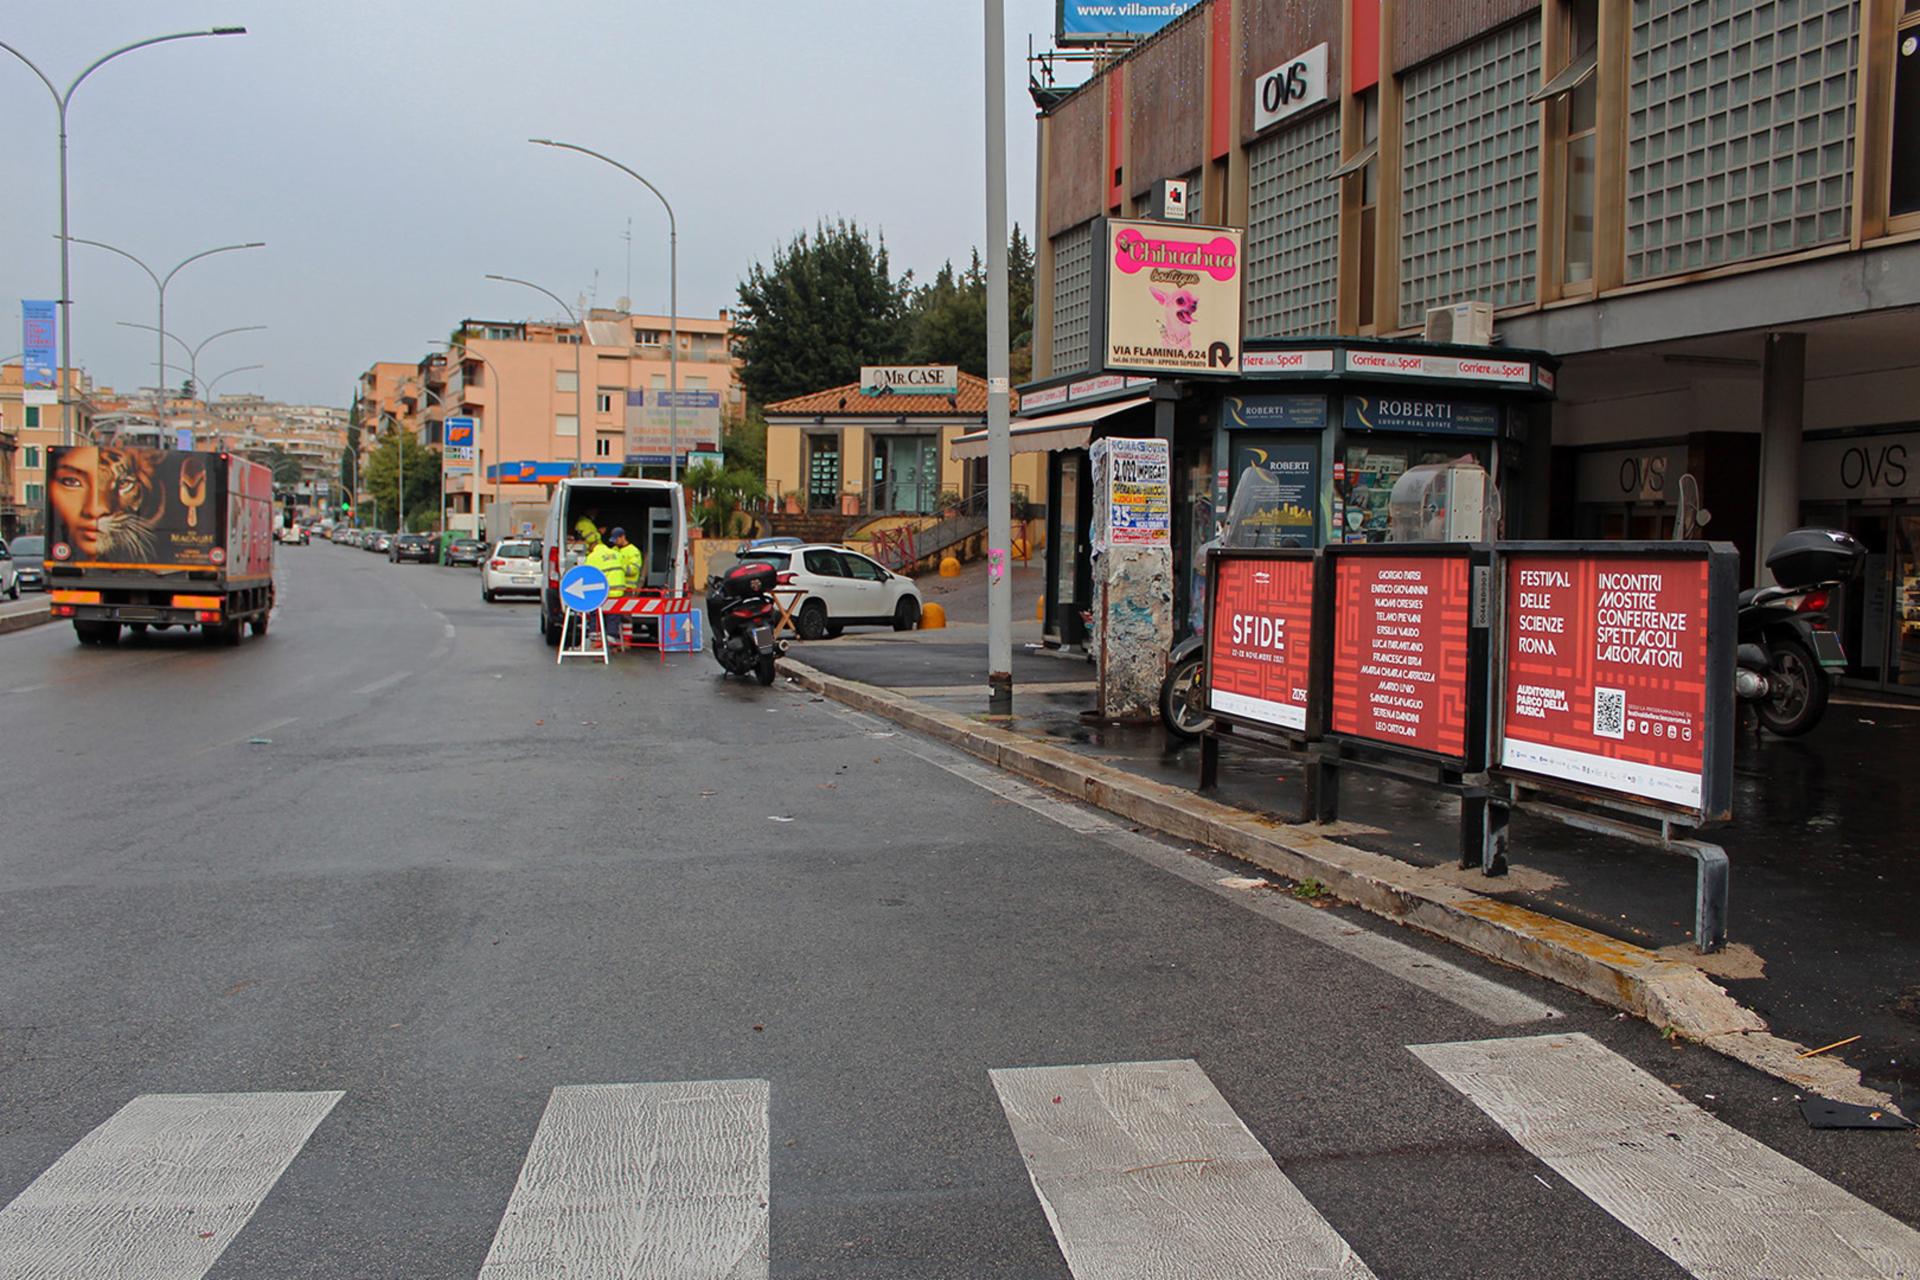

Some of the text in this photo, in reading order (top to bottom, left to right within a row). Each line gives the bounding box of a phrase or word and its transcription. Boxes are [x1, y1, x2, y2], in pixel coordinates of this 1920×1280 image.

[1077, 3, 1188, 16] www. villamafal
[1263, 62, 1307, 112] OVS
[1129, 239, 1234, 268] Chihuahua
[1150, 268, 1200, 288] boutique
[1113, 345, 1131, 356] VIA
[1244, 356, 1264, 366] riere
[1276, 354, 1303, 368] Sport
[1352, 354, 1386, 367] Corriere
[1398, 357, 1422, 370] Sport
[1459, 362, 1491, 374] Corriere
[1502, 365, 1524, 378] Sport
[908, 369, 944, 384] CASE
[1246, 406, 1284, 415] ROBERTI
[1379, 400, 1450, 418] ROBERTI
[1270, 461, 1310, 471] ROBERTI
[1620, 457, 1664, 493] OVS
[1840, 444, 1907, 488] OVS
[1520, 570, 1571, 588] FESTIVAL
[1598, 573, 1662, 592] INCONTRI
[1520, 592, 1551, 610] DELLE
[1598, 592, 1656, 610] MOSTRE
[1520, 614, 1564, 633] SCIENZE
[1598, 608, 1687, 631] CONFERENZE
[1232, 614, 1286, 650] SFIDE
[1597, 626, 1676, 648] SPETTACOLI
[1518, 636, 1557, 656] ROMA
[1597, 644, 1682, 669] LABORATORI
[1517, 684, 1565, 700] AUDITORIUM
[1516, 694, 1569, 712] PARCO DELLA
[1516, 704, 1546, 718] MUSICA
